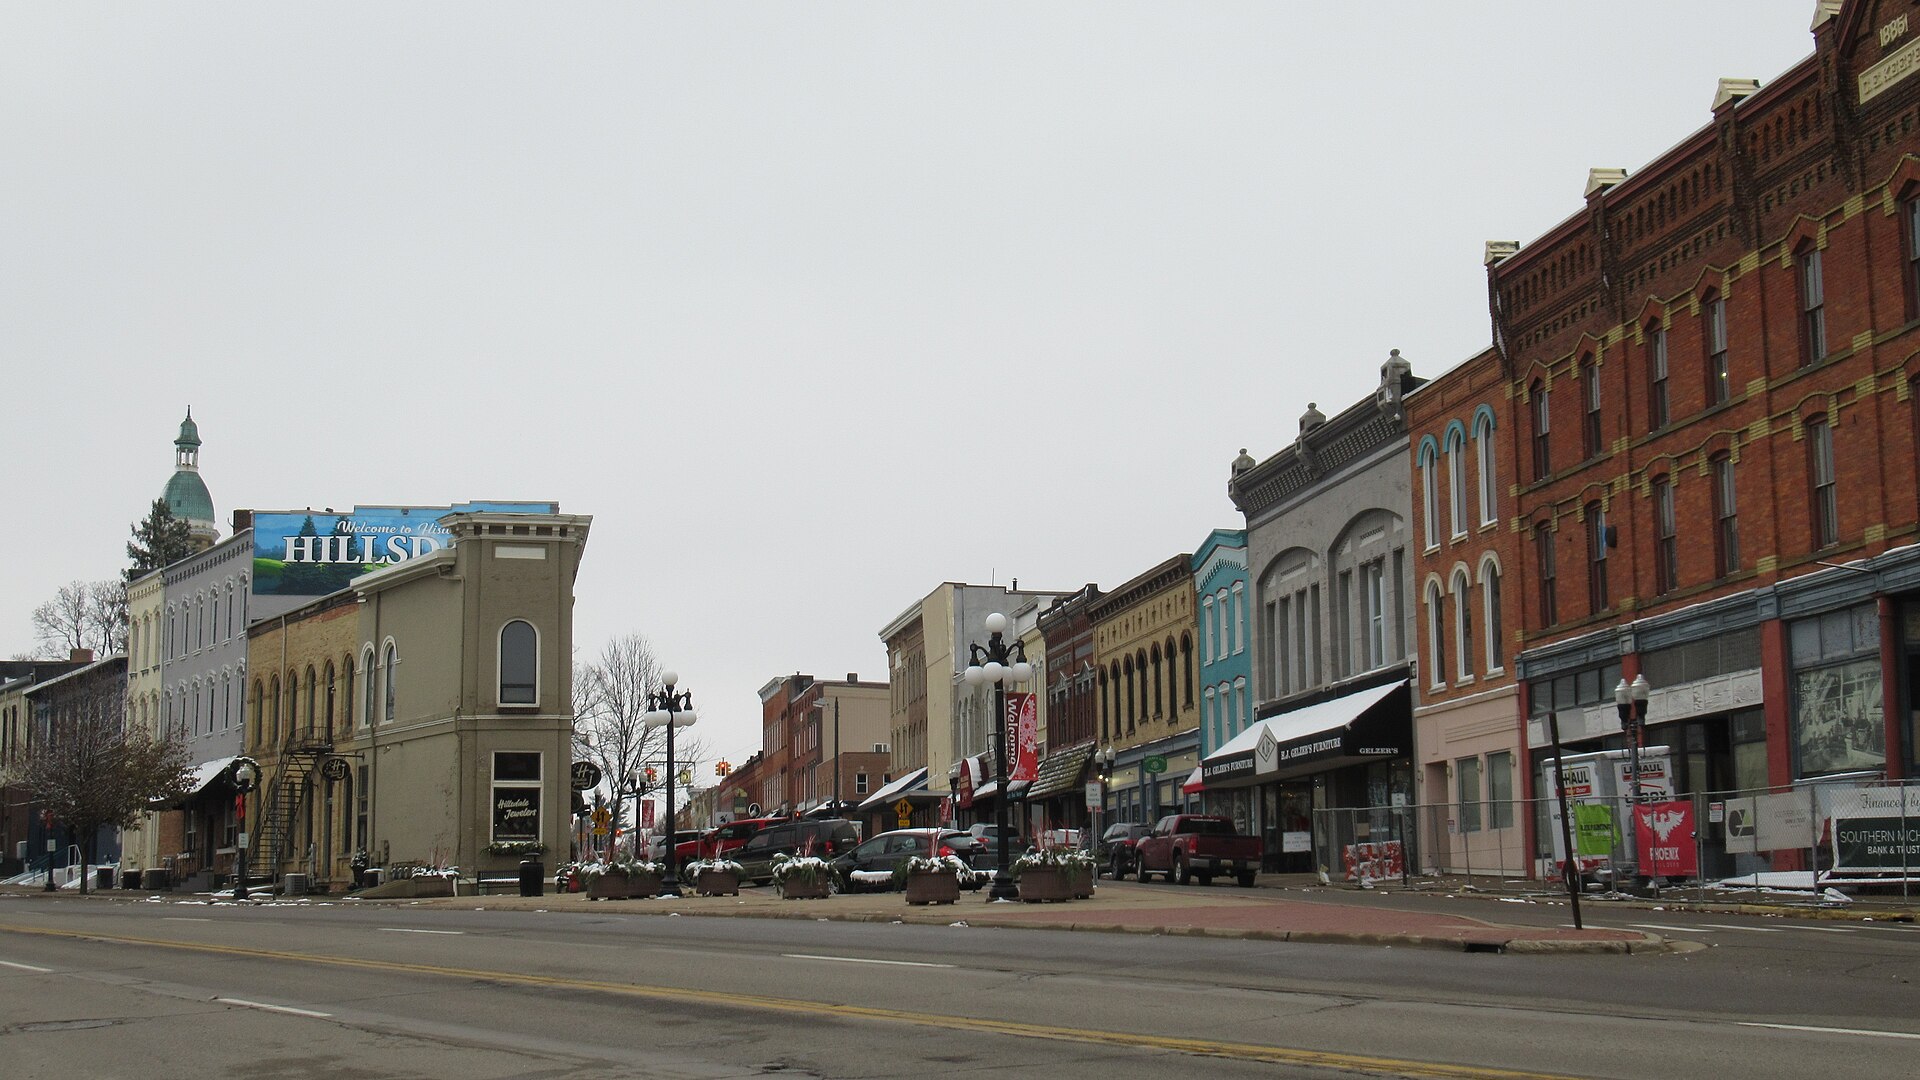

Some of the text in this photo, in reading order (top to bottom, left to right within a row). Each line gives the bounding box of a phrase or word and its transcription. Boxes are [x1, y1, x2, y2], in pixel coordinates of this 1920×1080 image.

[337, 520, 397, 534] Welcome
[400, 525, 412, 534] to
[1007, 698, 1017, 765] Welcome
[1290, 744, 1312, 758] GELZER'S
[1313, 737, 1341, 753] FURNITURE
[1359, 747, 1399, 755] GELZER'S
[1230, 758, 1253, 771] FURNITURE
[497, 799, 530, 809] Hillsdale
[504, 808, 537, 820] Jewelers
[1840, 830, 1895, 844] SOUTHERN
[1867, 846, 1888, 855] BANK
[1889, 846, 1895, 854] &
